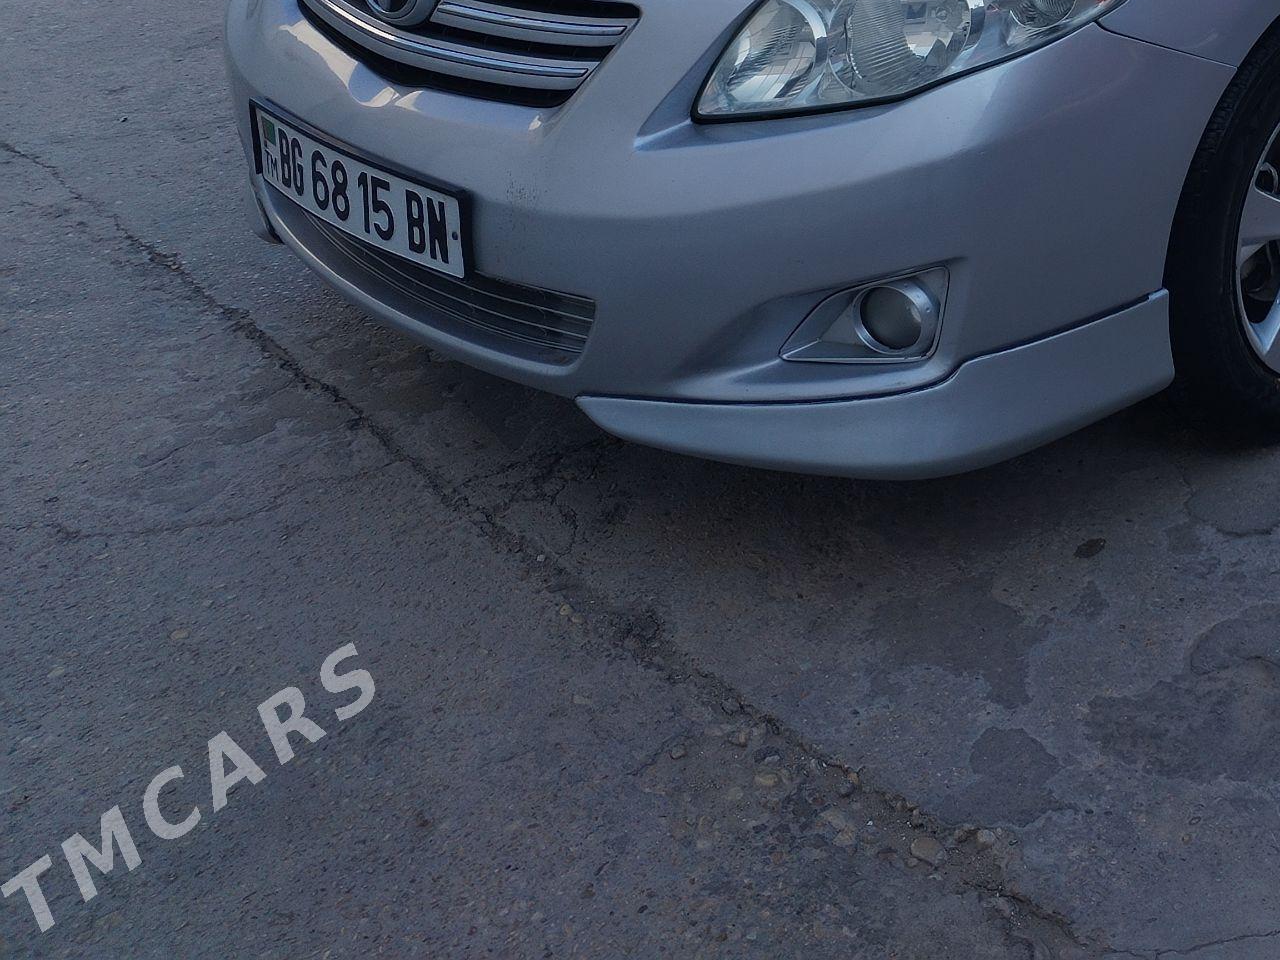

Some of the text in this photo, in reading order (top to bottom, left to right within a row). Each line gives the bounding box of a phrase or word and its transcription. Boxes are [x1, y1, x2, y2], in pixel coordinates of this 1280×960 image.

[265, 149, 279, 181] TM
[278, 127, 449, 264] BG 68 15 BN
